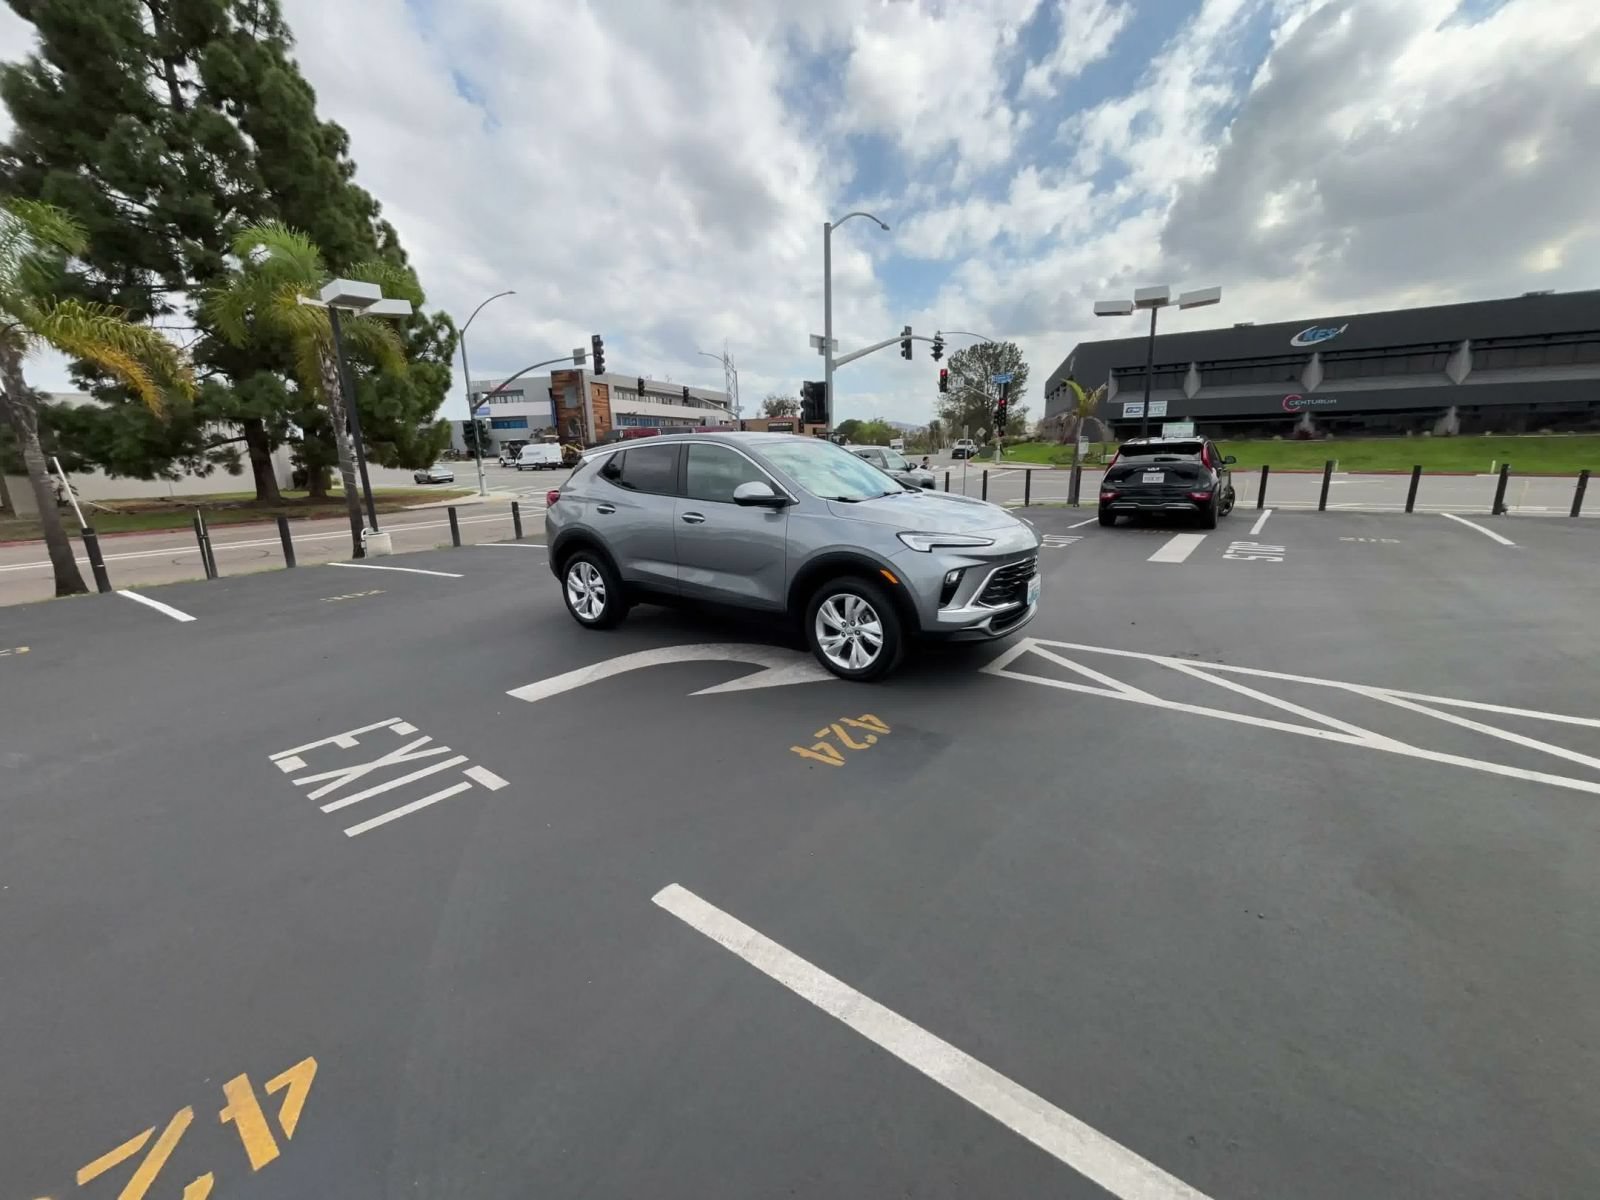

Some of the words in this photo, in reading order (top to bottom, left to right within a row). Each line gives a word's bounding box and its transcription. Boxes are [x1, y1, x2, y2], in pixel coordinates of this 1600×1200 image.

[1222, 541, 1287, 562] STOP
[268, 717, 511, 838] EXIT
[789, 713, 891, 767] 424
[32, 1056, 318, 1200] 42
